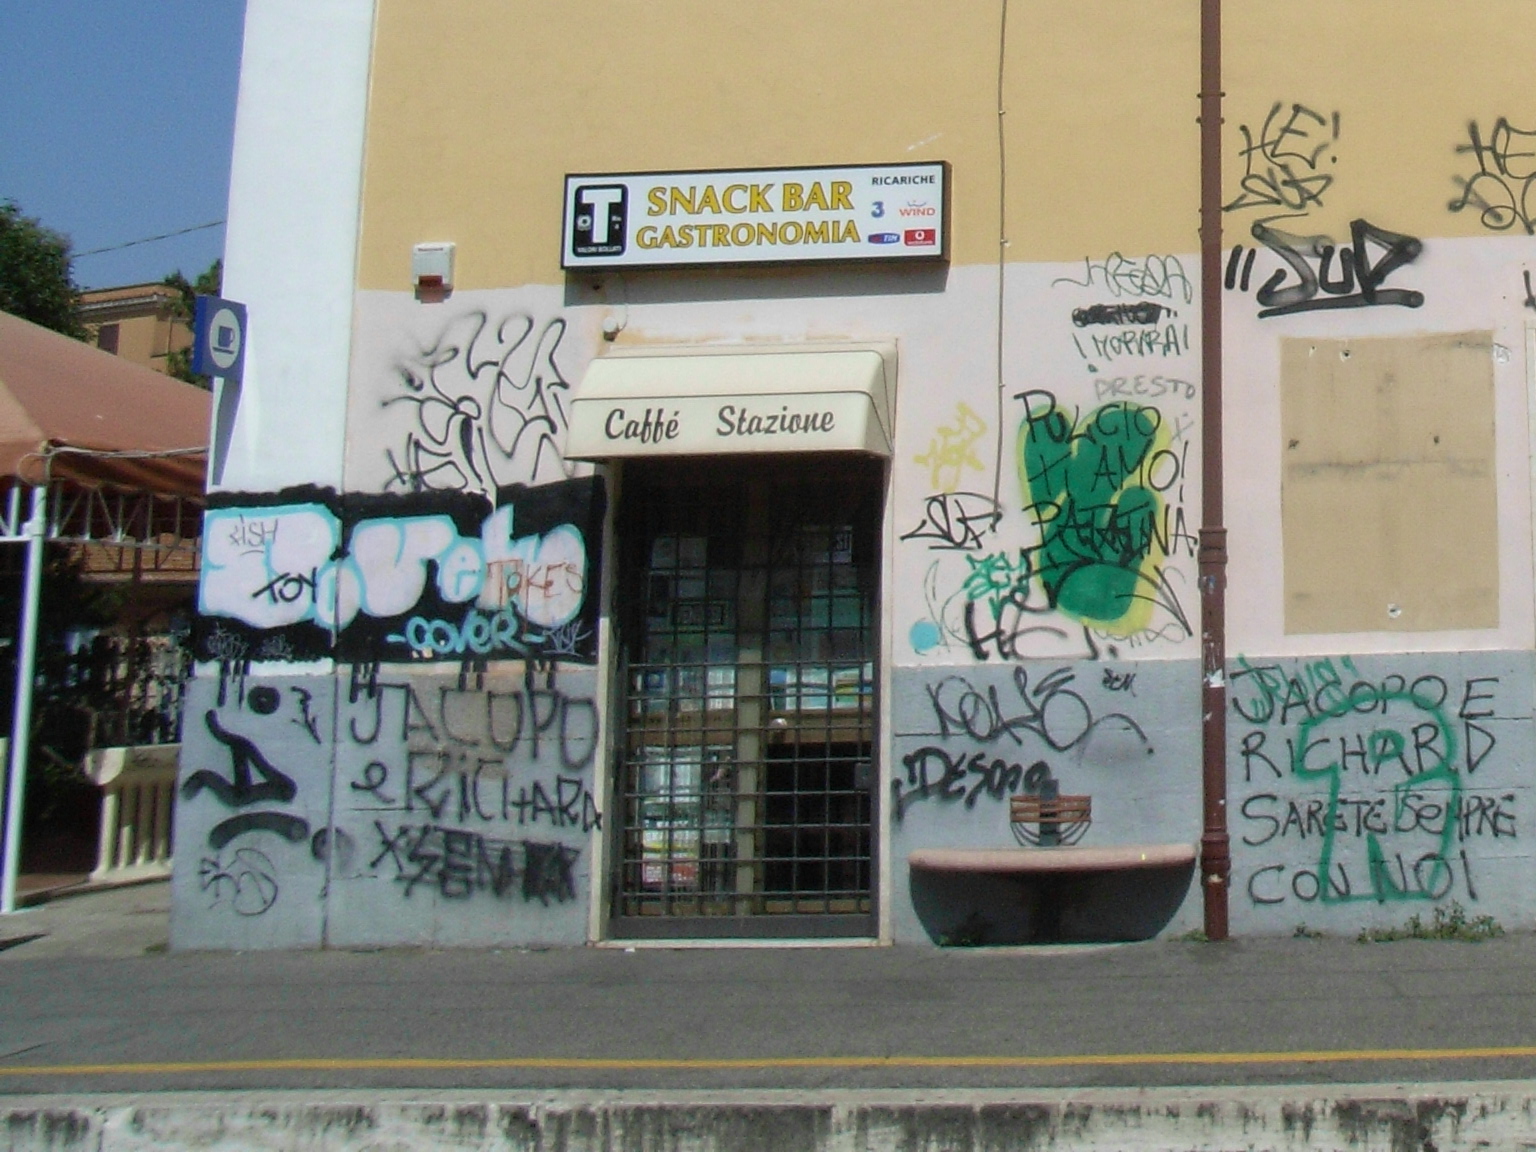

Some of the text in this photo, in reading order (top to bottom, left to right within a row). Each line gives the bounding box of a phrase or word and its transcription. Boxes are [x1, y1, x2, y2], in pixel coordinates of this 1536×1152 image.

[647, 180, 855, 217] SNACK BAR
[871, 174, 936, 186] RICARICHE
[582, 188, 622, 244] T
[871, 200, 936, 219] 3 WIND
[635, 219, 861, 250] GASTRONOMIA
[604, 404, 836, 444] Caffé Stazione
[1240, 722, 1497, 782] RICHARD
[1240, 793, 1389, 847] SARETE
[1247, 862, 1352, 905] CON
